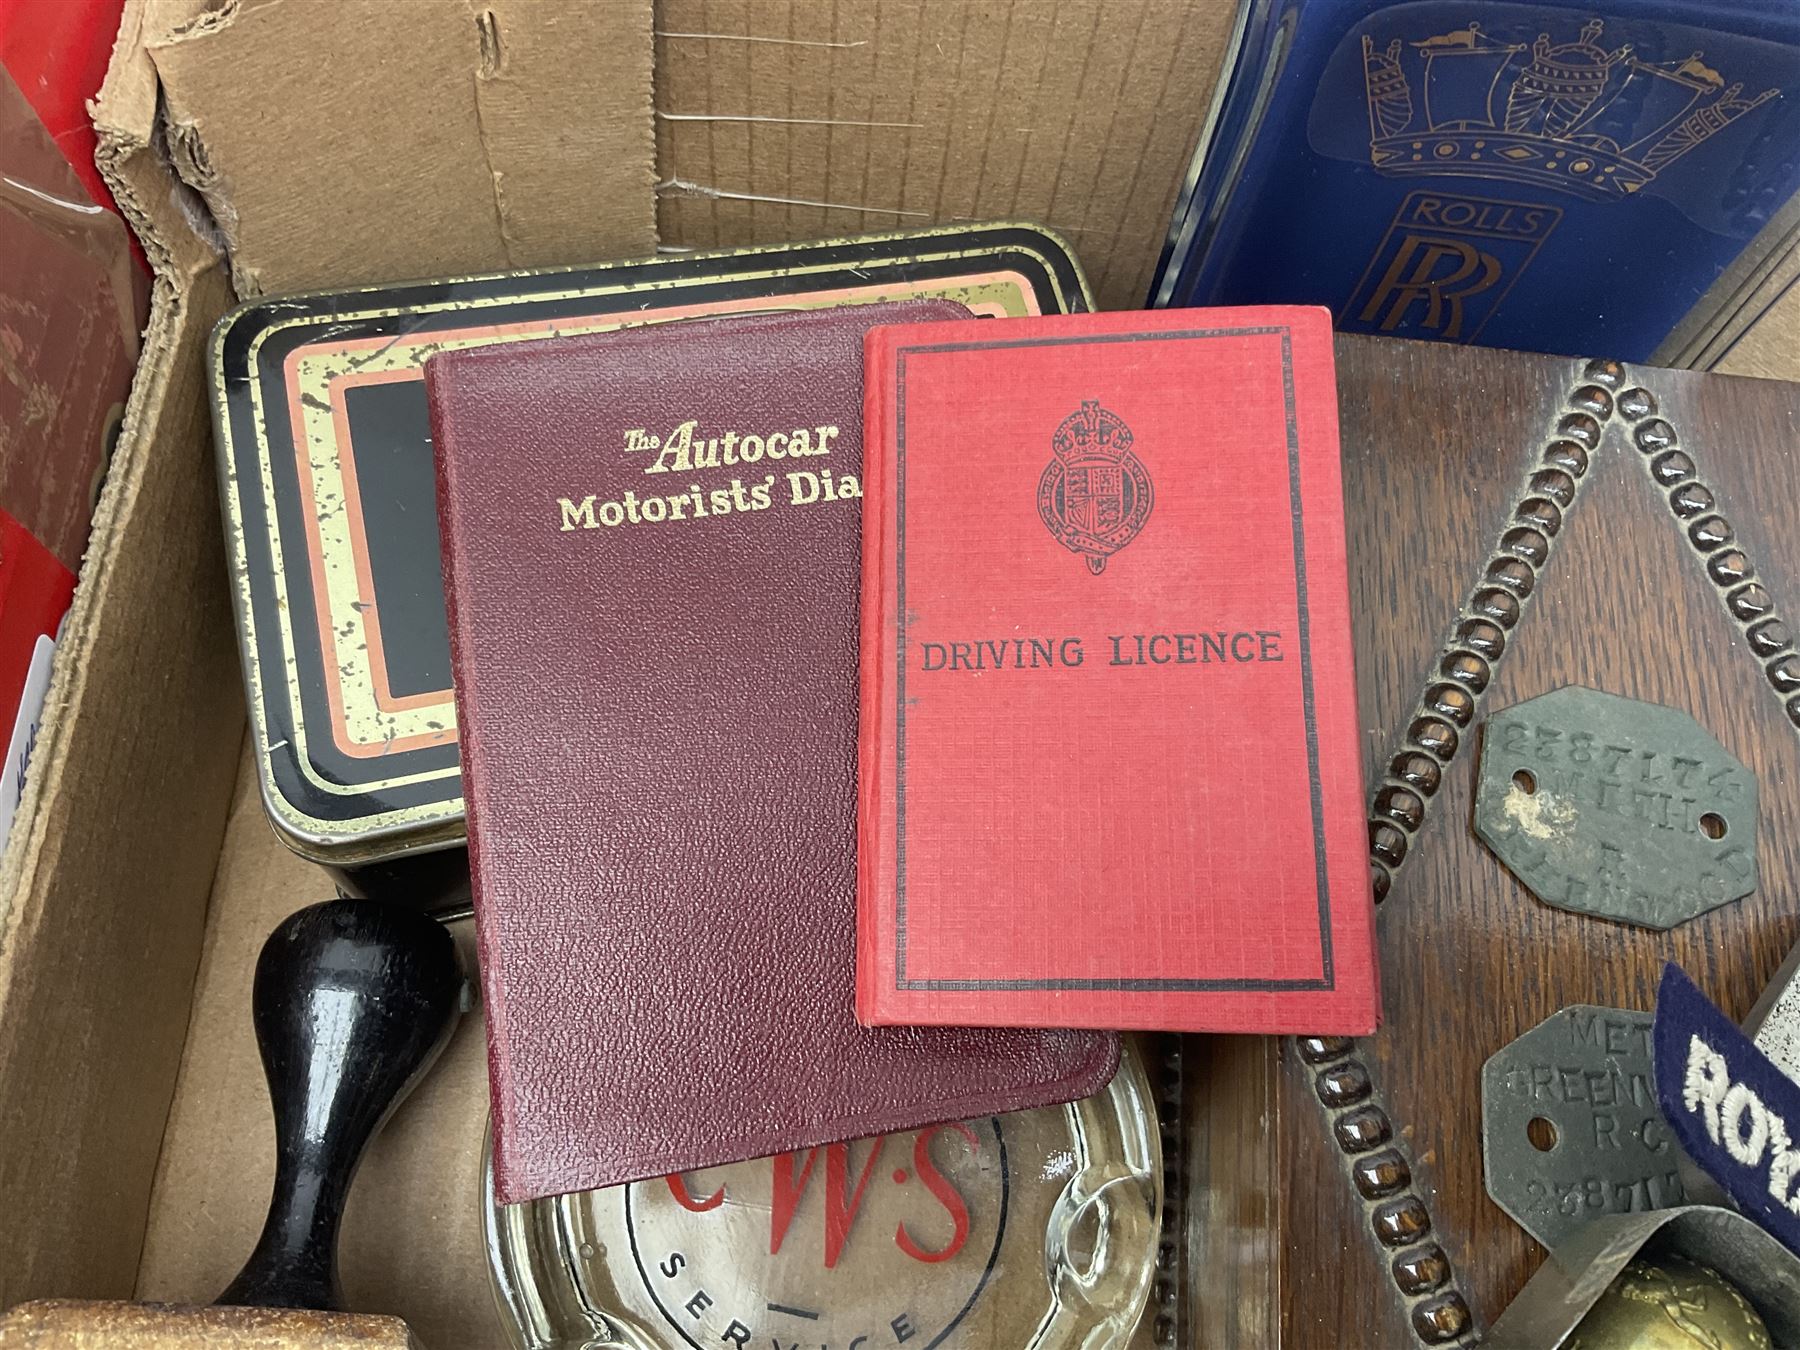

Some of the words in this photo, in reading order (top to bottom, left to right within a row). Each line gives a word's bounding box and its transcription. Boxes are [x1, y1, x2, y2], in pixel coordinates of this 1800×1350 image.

[1412, 199, 1544, 234] ROLLS
[624, 428, 661, 452] The
[643, 419, 839, 475] Autocar
[556, 475, 775, 532] Motorists'
[920, 637, 1085, 671] DRIVING
[1107, 630, 1285, 666] LICENCE
[1682, 1033, 1800, 1214] ROY
[659, 1252, 916, 1350] SERCE
